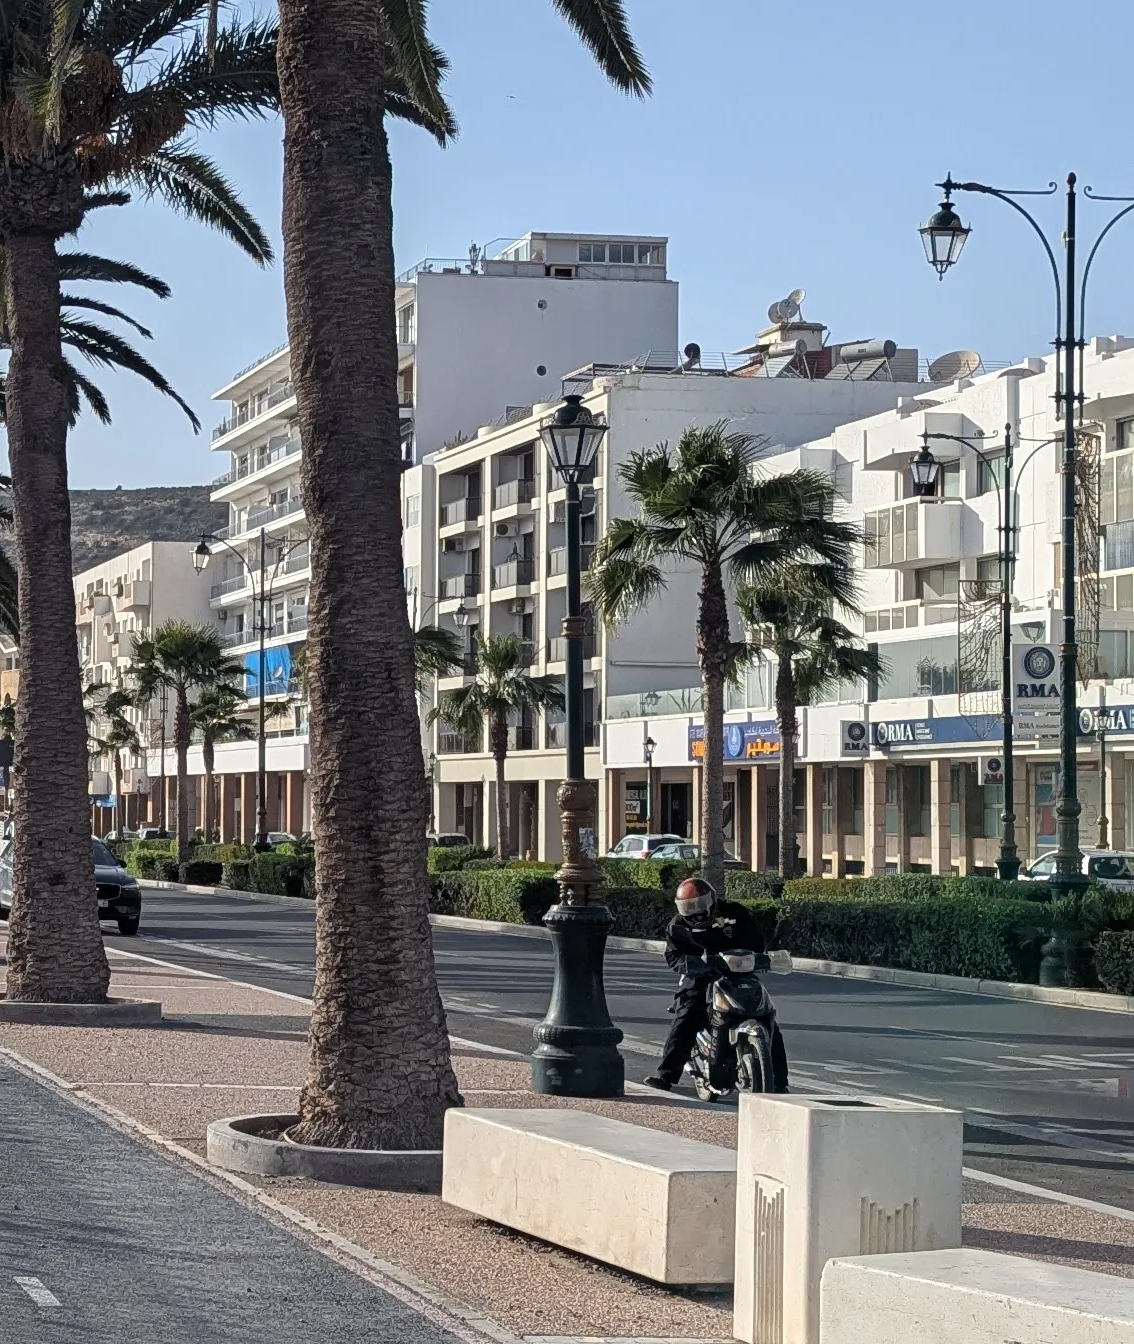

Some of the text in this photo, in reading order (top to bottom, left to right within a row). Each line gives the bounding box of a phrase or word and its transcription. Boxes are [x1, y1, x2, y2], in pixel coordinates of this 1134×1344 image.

[1017, 684, 1061, 698] RMA
[887, 723, 914, 742] RMA
[844, 742, 869, 751] RMA
